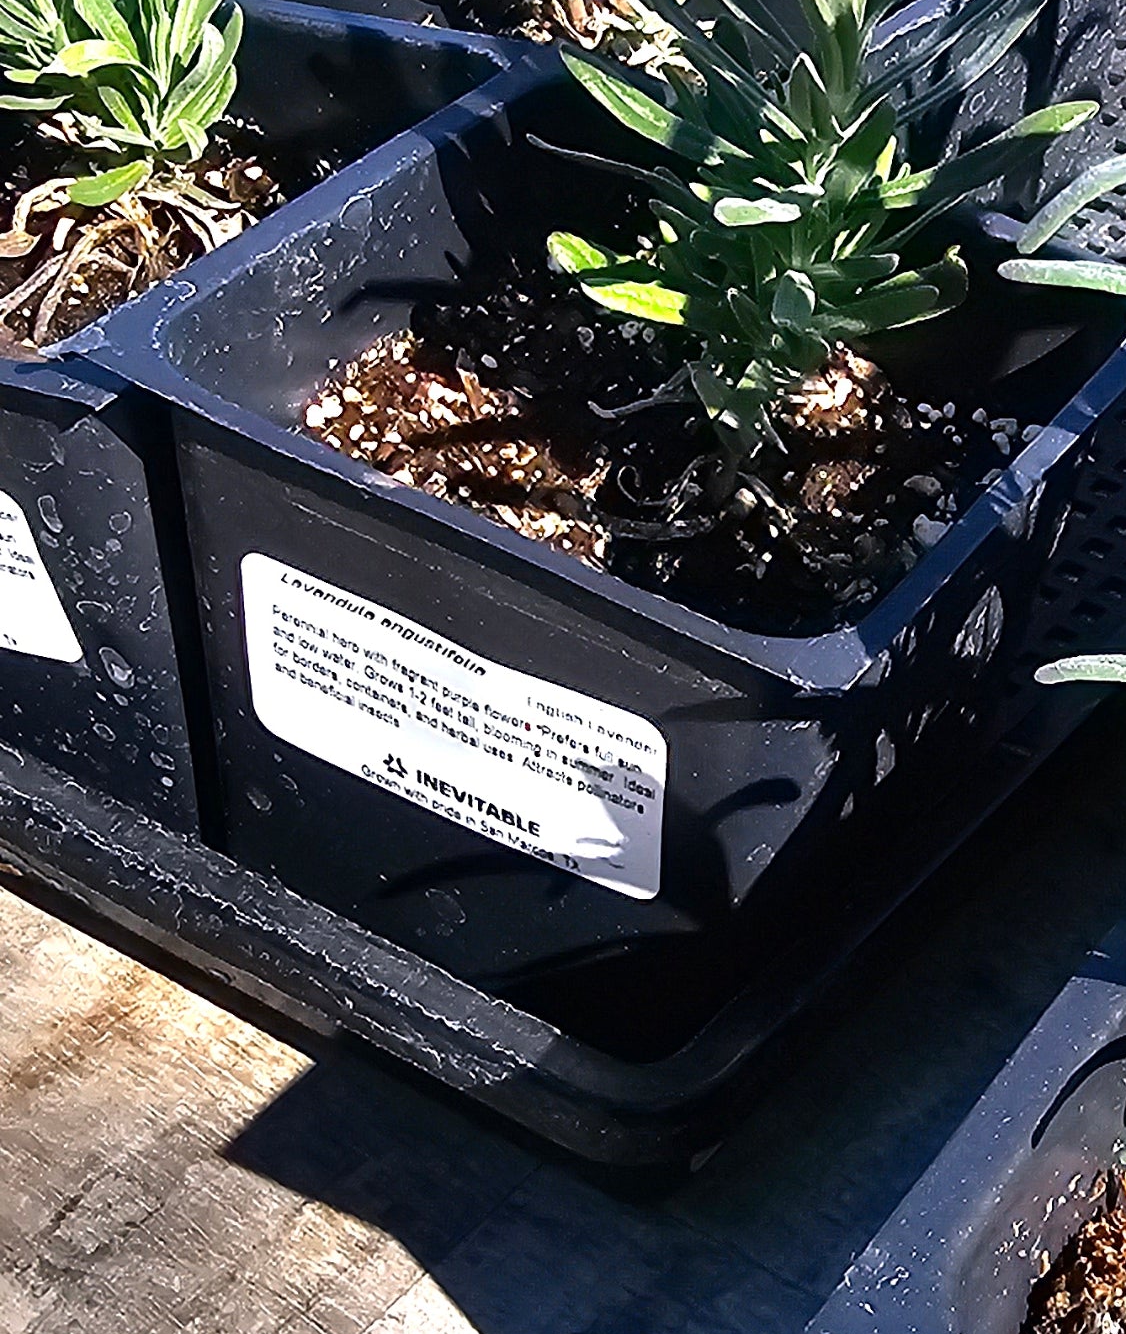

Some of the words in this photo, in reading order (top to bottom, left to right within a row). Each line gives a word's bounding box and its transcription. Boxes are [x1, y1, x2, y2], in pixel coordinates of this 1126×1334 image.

[273, 604, 328, 640] Perennial
[332, 632, 359, 654] herb
[363, 648, 388, 666] with
[392, 658, 438, 692] fragrant
[442, 686, 480, 712] purple
[281, 573, 375, 620] Lavandula
[381, 618, 486, 676] angustifolia
[273, 626, 294, 643] and
[298, 635, 318, 654] low
[364, 664, 404, 693] Grows
[409, 686, 427, 706] 1-2
[431, 697, 453, 719] feet
[484, 723, 541, 758] blooming
[546, 749, 558, 760] in
[273, 642, 288, 658] for
[416, 711, 437, 729] and
[441, 721, 480, 748] herbal
[522, 756, 572, 786] Attracts
[275, 662, 297, 680] and
[299, 672, 355, 706] beneficial
[361, 764, 401, 791] Grown
[404, 786, 428, 804] with
[465, 815, 476, 826] in
[480, 820, 504, 837] San
[416, 769, 541, 838] INEVITABLE
